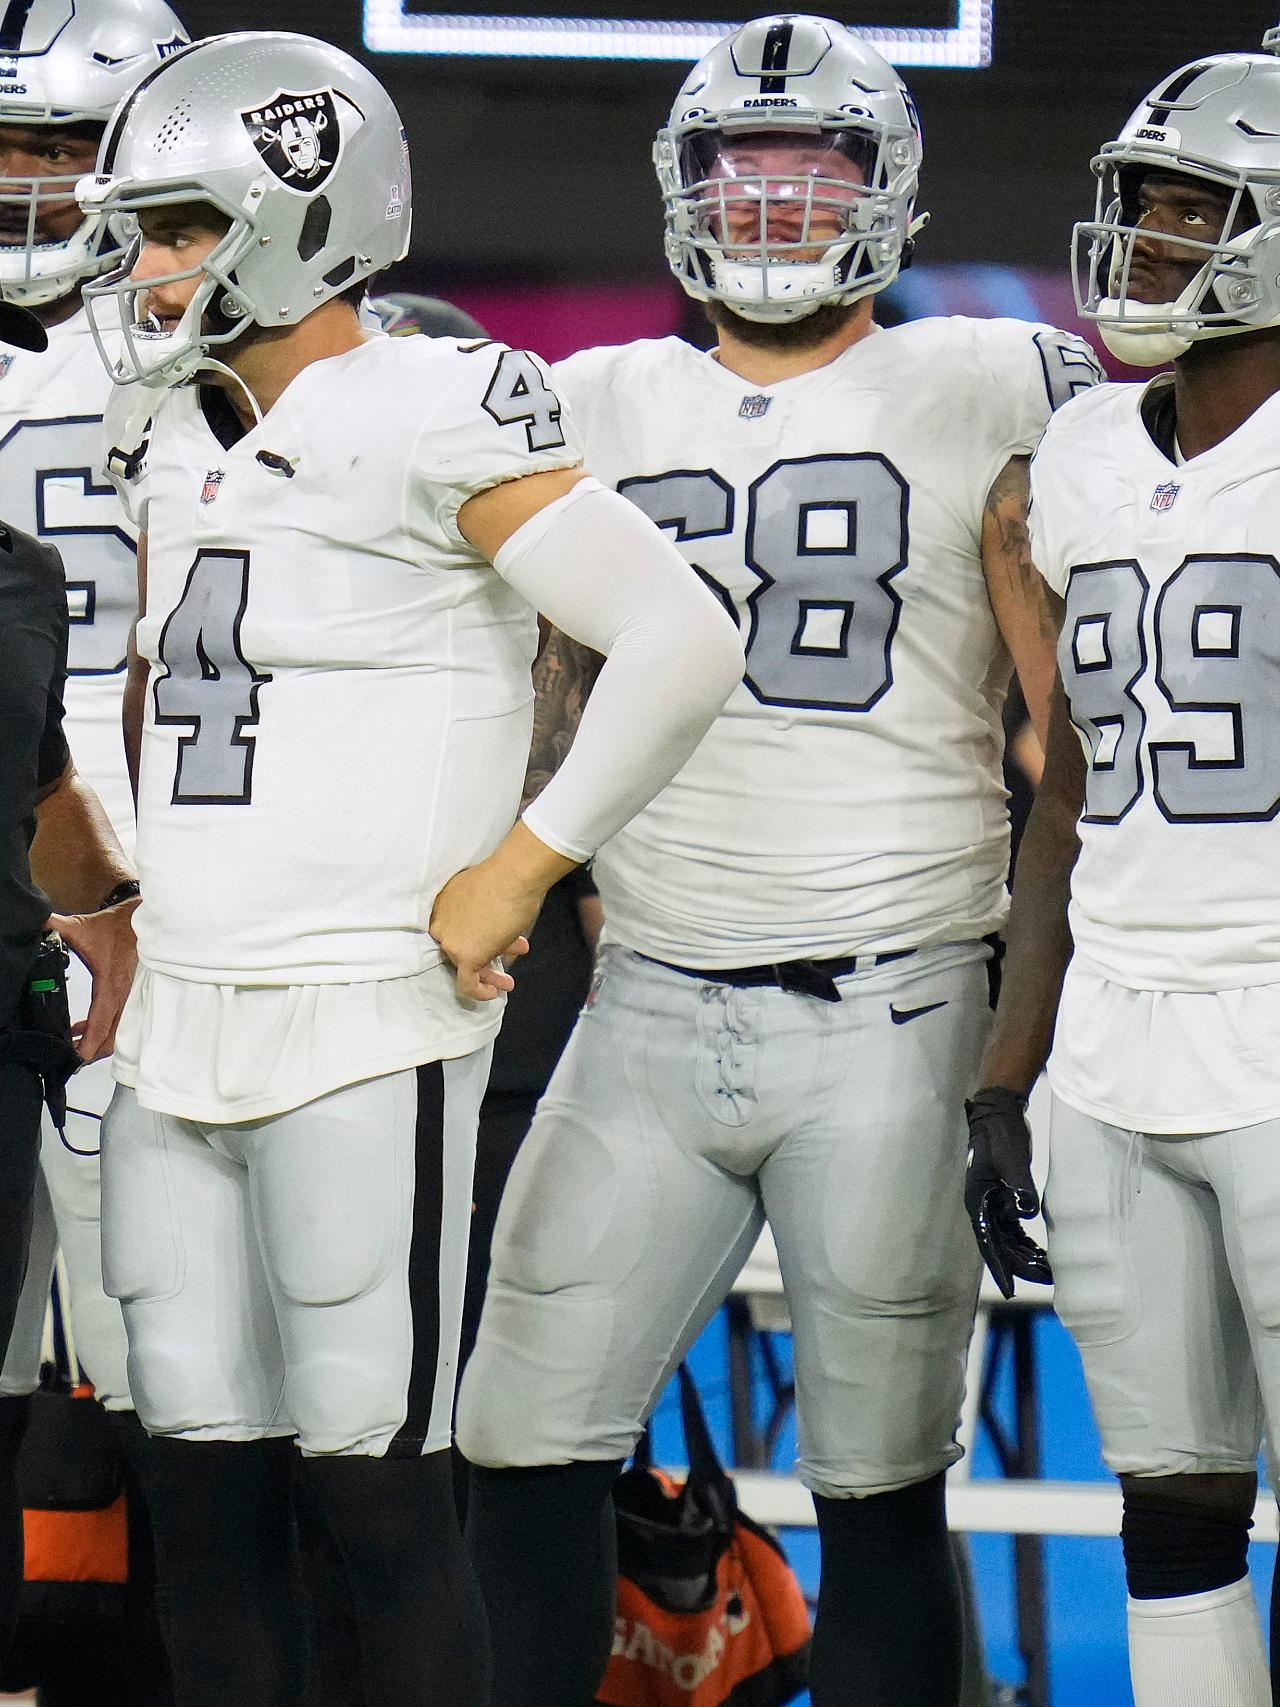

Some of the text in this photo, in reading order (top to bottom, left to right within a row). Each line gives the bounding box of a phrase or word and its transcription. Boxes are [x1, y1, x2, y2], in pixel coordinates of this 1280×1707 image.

[250, 95, 326, 124] RAIDERS
[743, 98, 797, 107] RAIDERS
[1133, 128, 1167, 142] IDERS
[480, 349, 566, 453] 4
[154, 547, 273, 805] 4
[1056, 552, 1280, 825] 89
